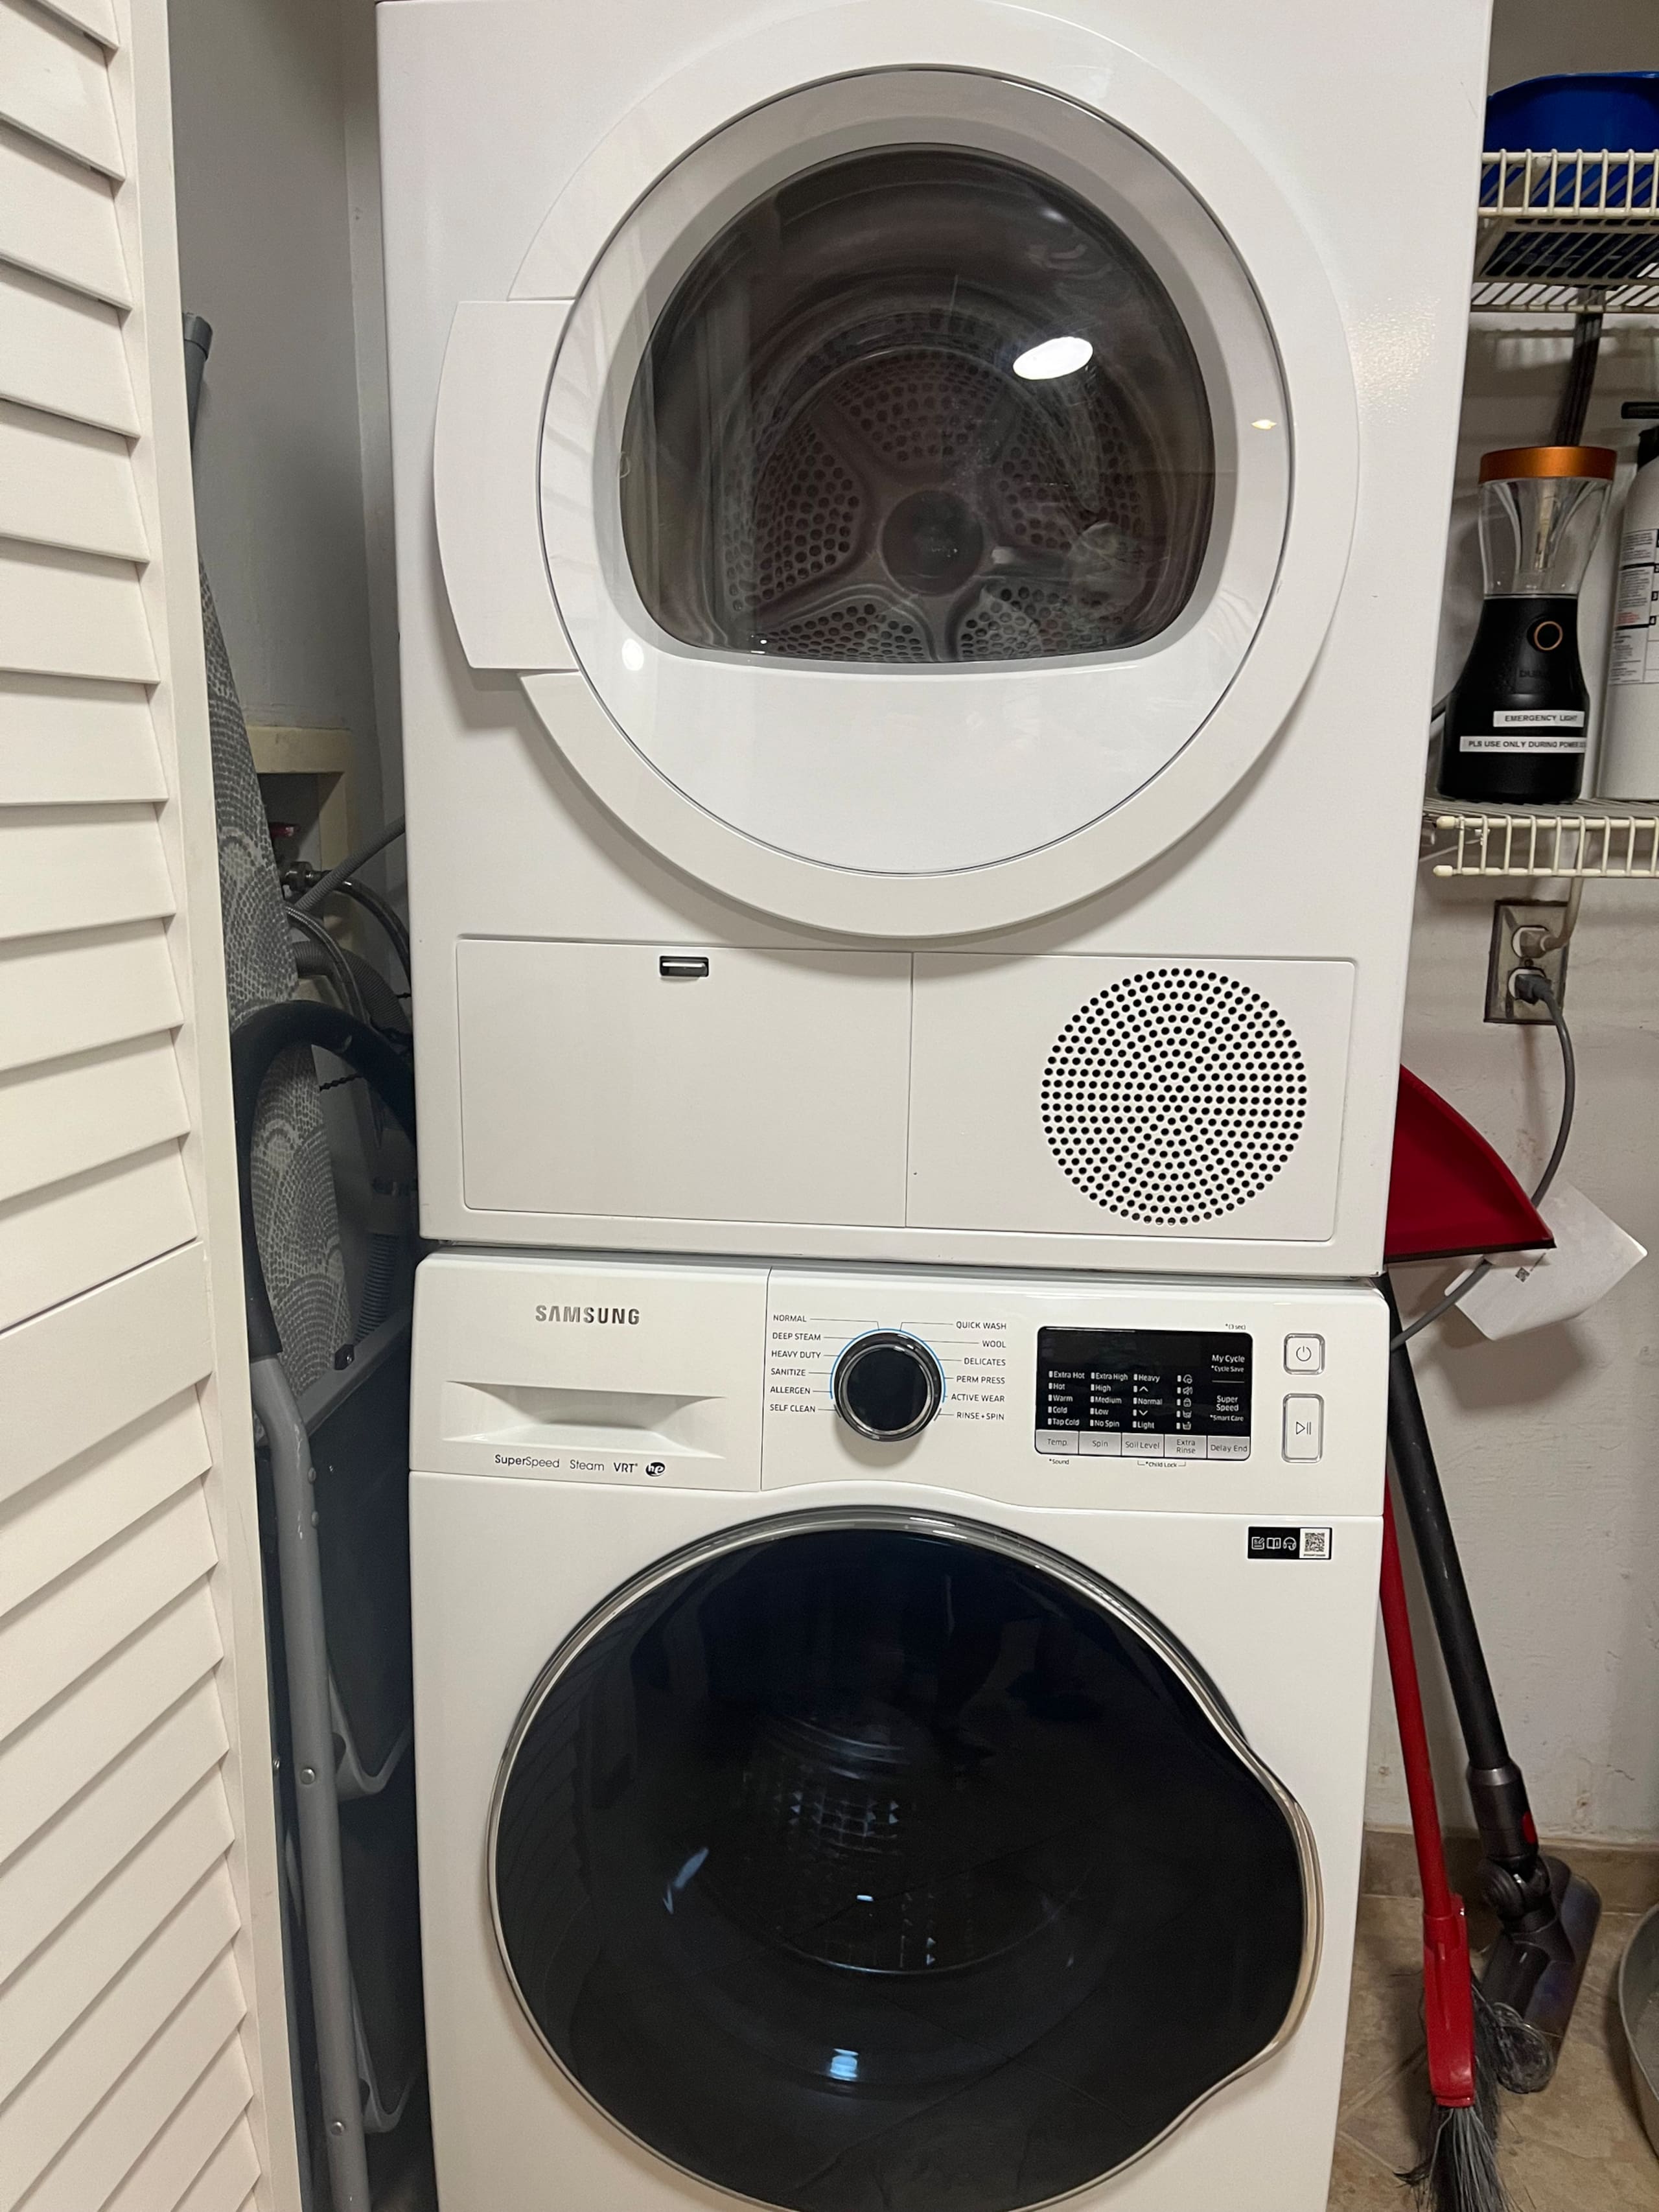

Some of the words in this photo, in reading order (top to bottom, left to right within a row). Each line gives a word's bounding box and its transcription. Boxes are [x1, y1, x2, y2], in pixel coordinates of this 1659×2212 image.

[535, 1305, 640, 1325] SAMSUNG
[956, 1321, 980, 1329] QUICK
[795, 1333, 821, 1341] STEAM
[982, 1340, 1006, 1348] WOOL
[964, 1357, 1006, 1366] DELICATES
[1212, 1354, 1224, 1363] My
[1225, 1355, 1246, 1363] Cycle
[771, 1368, 806, 1376] SANITIZE
[981, 1376, 1006, 1384] PRESS
[1113, 1373, 1128, 1382] High
[1138, 1374, 1160, 1383] Heavy
[770, 1386, 811, 1395] ALLERGEN
[1095, 1384, 1111, 1393] High
[951, 1393, 979, 1401] ACTIVE
[1095, 1396, 1122, 1404] Medium
[1216, 1395, 1238, 1404] Super
[790, 1404, 816, 1413] CLEAN
[1216, 1403, 1239, 1412] Speed
[1052, 1418, 1065, 1426] Tap
[1137, 1421, 1155, 1430] Light
[494, 1454, 560, 1468] SuperSpeed
[570, 1460, 605, 1471] Steam
